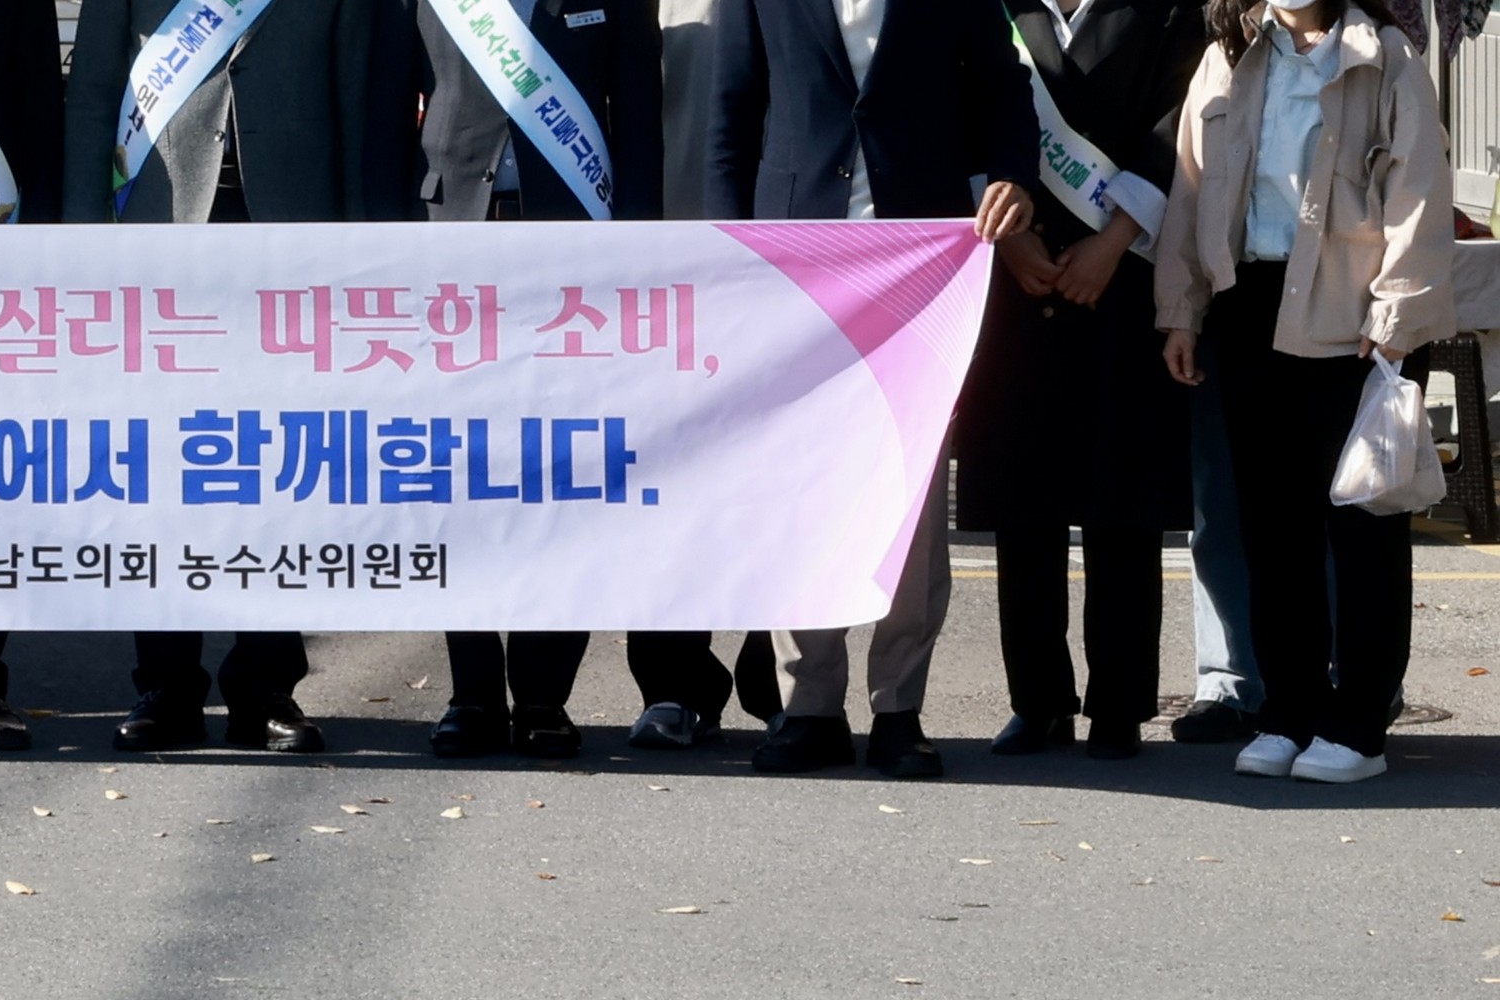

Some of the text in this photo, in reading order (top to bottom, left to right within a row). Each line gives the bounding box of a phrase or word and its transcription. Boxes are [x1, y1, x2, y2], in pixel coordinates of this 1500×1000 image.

[123, 3, 224, 147] 전통시장에서!
[469, 12, 552, 100] 농수산물,
[255, 283, 506, 374] 따뜻한
[532, 283, 720, 379] 소비,
[178, 408, 660, 507] 함께합니다.
[177, 542, 449, 590] 농수산위원회
